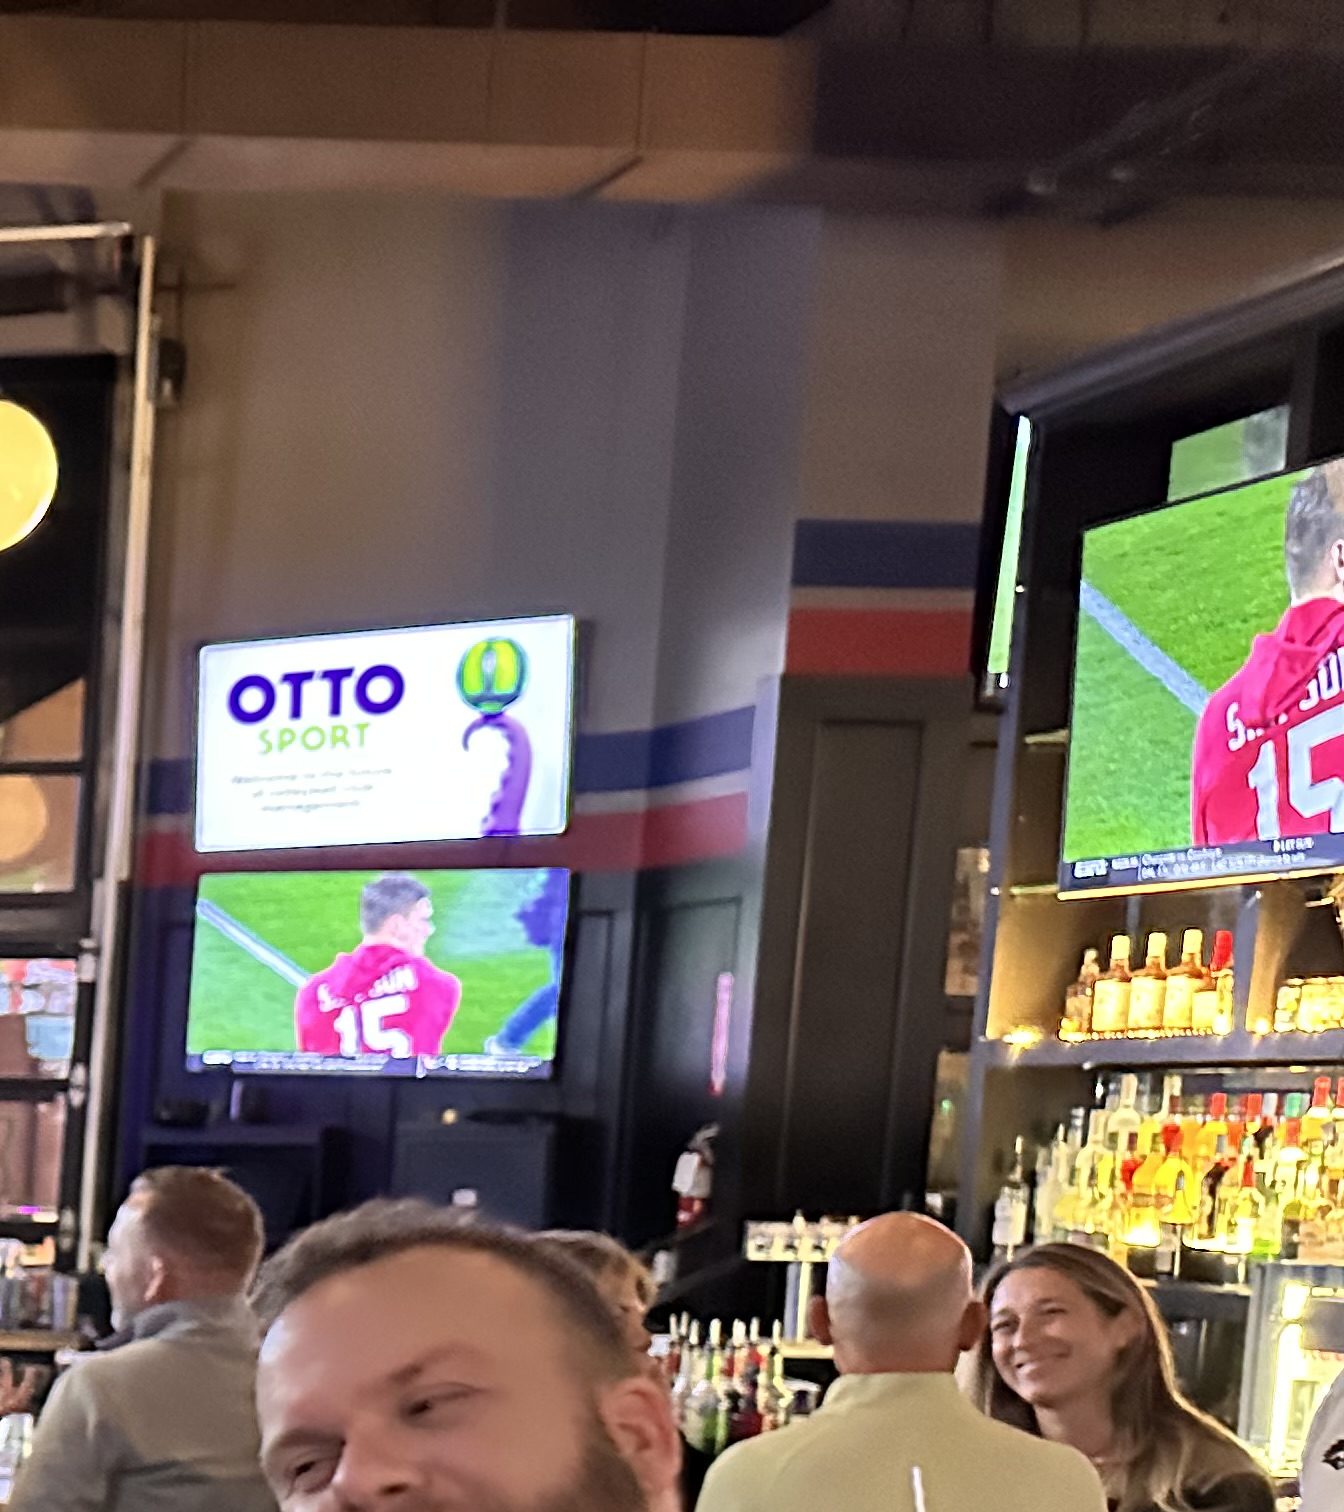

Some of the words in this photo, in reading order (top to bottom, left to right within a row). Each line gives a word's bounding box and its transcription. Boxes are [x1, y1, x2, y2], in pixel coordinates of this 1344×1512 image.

[226, 664, 405, 726] OTTO
[258, 722, 370, 755] SPORT
[334, 994, 411, 1059] 15
